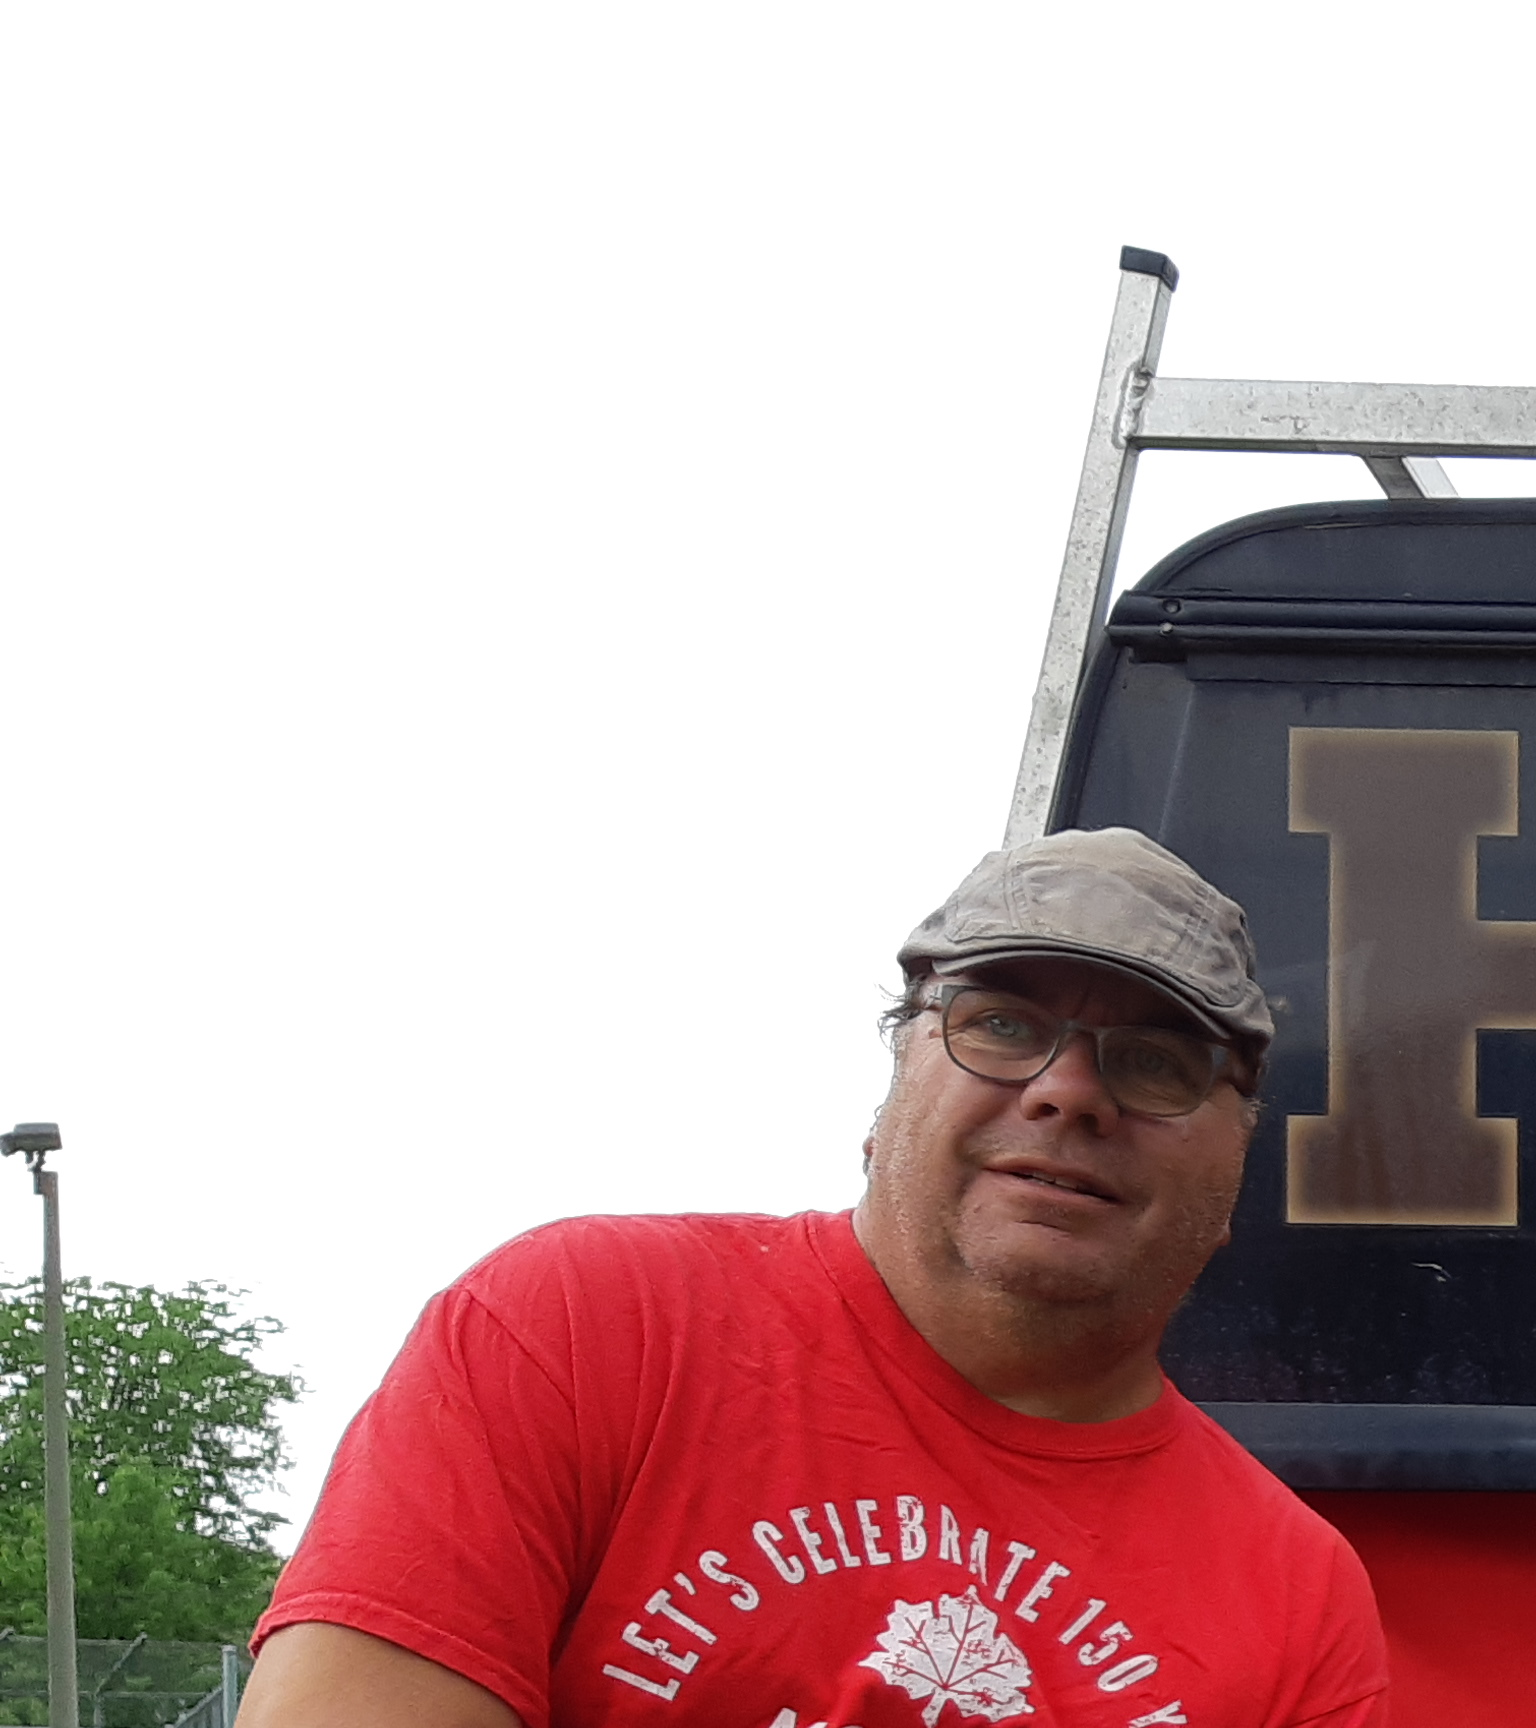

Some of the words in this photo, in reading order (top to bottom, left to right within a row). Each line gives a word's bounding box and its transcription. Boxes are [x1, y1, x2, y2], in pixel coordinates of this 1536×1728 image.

[602, 1549, 760, 1702] LET'S
[752, 1495, 1070, 1622] CELEBRATE
[1058, 1598, 1158, 1692] 150
